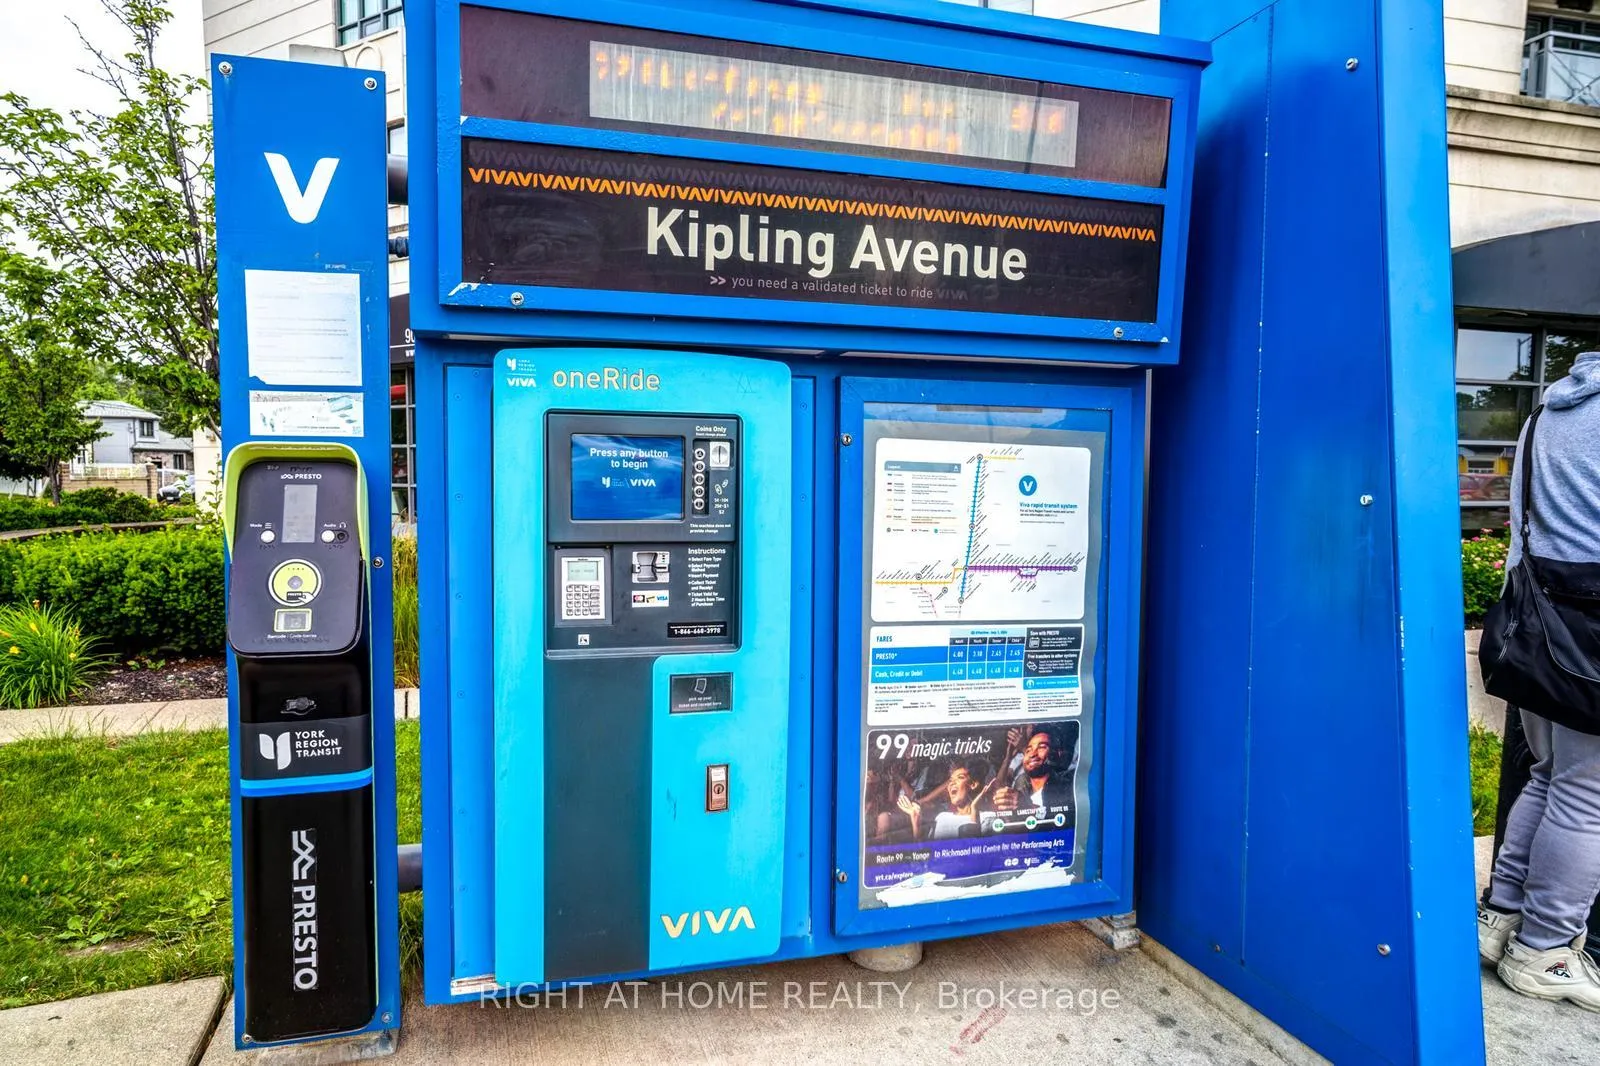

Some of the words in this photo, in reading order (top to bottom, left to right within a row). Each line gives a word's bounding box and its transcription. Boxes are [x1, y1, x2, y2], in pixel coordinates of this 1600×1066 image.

[646, 206, 835, 278] Kipling
[850, 224, 1028, 281] Avenue
[731, 277, 753, 288] you
[758, 278, 787, 289] need
[791, 281, 799, 289] a
[802, 279, 857, 293] validated
[860, 284, 893, 296] ticket
[896, 286, 907, 297] to
[911, 287, 933, 299] ride
[506, 378, 537, 388] VIVA
[553, 367, 660, 391] oneRide
[713, 426, 727, 434] Only
[590, 448, 617, 457] Press
[620, 450, 636, 459] any
[639, 449, 669, 458] button
[611, 460, 620, 468] to
[622, 460, 648, 470] begin
[630, 479, 656, 487] VIVA
[295, 730, 325, 739] YORK
[295, 738, 339, 749] REGION
[876, 733, 910, 759] 99
[910, 738, 952, 760] magic
[954, 736, 992, 755] tricks
[296, 746, 342, 758] TRANSIT
[876, 855, 894, 863] Route
[895, 852, 903, 860] 99
[912, 852, 930, 861] Yonge
[934, 850, 941, 858] to
[941, 846, 971, 858] Richmond
[971, 846, 982, 855] Hill
[983, 844, 1001, 853] Centre
[1002, 842, 1010, 851] for
[1010, 841, 1020, 850] the
[1021, 840, 1052, 849] Performing
[1053, 838, 1065, 846] Arts
[875, 871, 914, 883] yrt.ca/explore
[660, 906, 756, 939] VIVA
[293, 884, 318, 990] PRESTO
